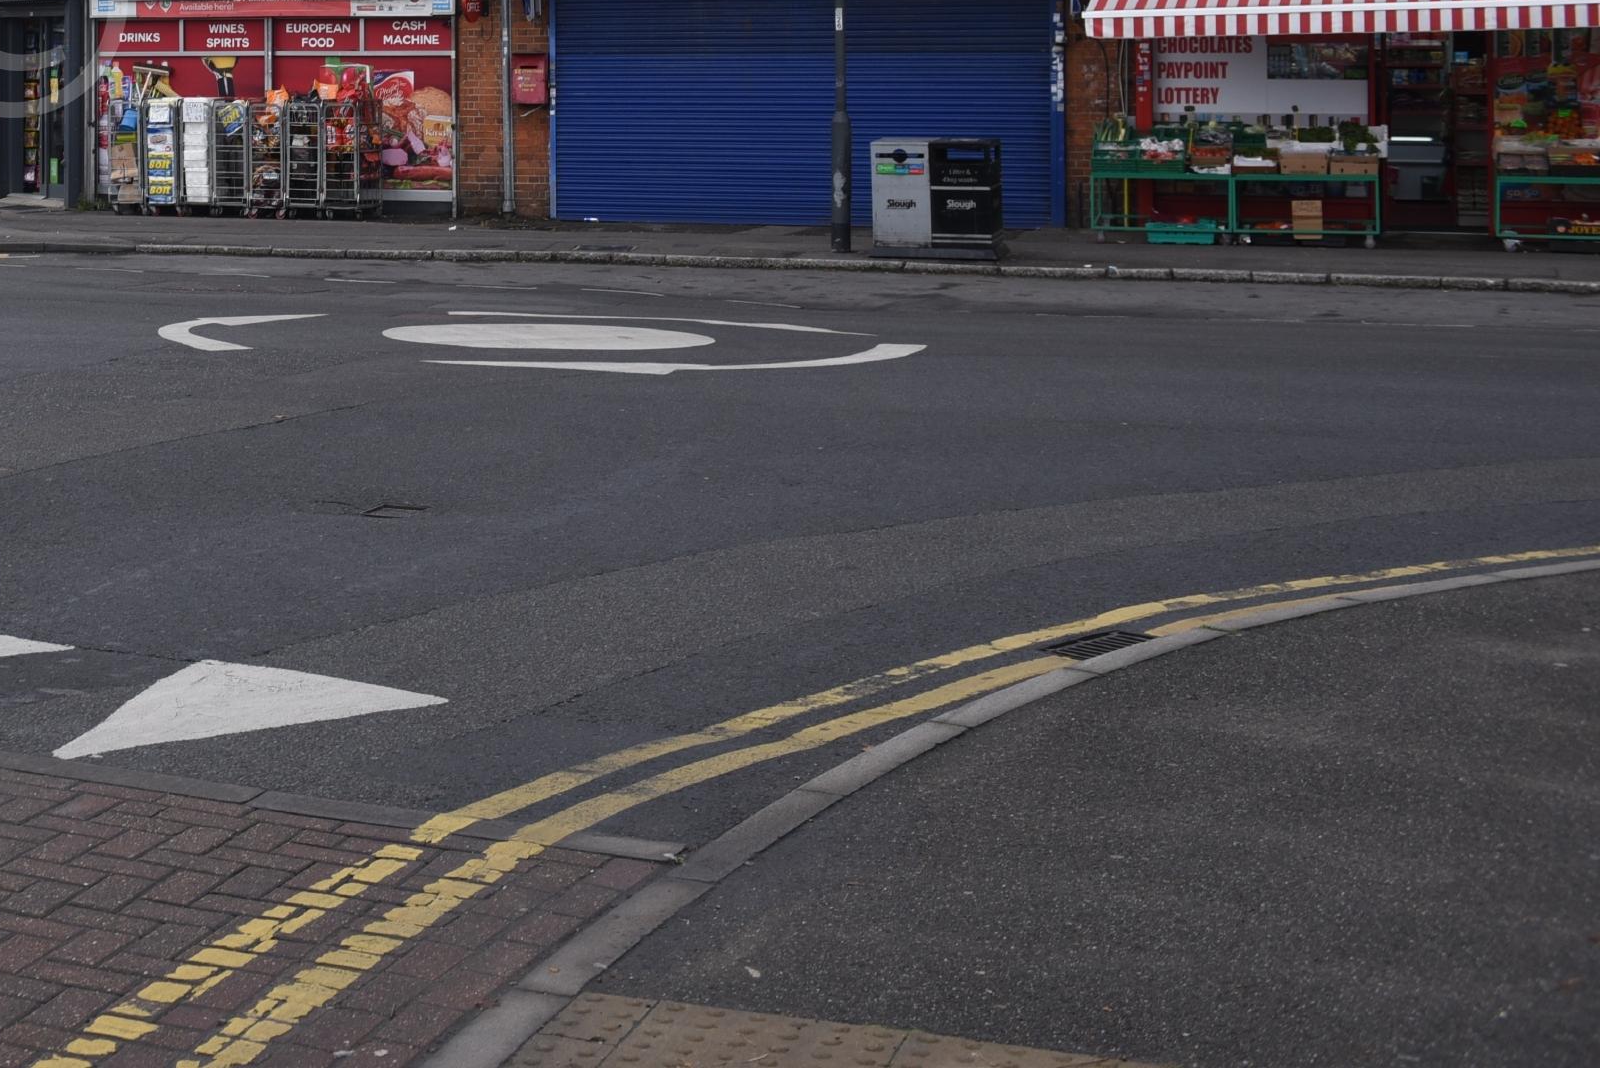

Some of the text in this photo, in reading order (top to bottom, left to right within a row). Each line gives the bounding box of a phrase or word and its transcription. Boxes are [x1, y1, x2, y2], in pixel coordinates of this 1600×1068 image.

[179, 3, 234, 12] Available here!
[466, 2, 481, 12] OFFICE
[208, 23, 248, 35] WINES,
[285, 22, 351, 34] EUROPEAN
[392, 20, 427, 31] CASH
[119, 32, 161, 43] DRINKS
[206, 37, 250, 48] SPIRITS
[301, 37, 335, 48] FOOD
[383, 34, 440, 45] MACHINE
[1157, 36, 1253, 54] CHOCOLATES
[1157, 61, 1229, 80] PAYPOINT
[1157, 87, 1220, 105] LOTTERY
[886, 198, 917, 210] Slough
[946, 199, 977, 210] Slough
